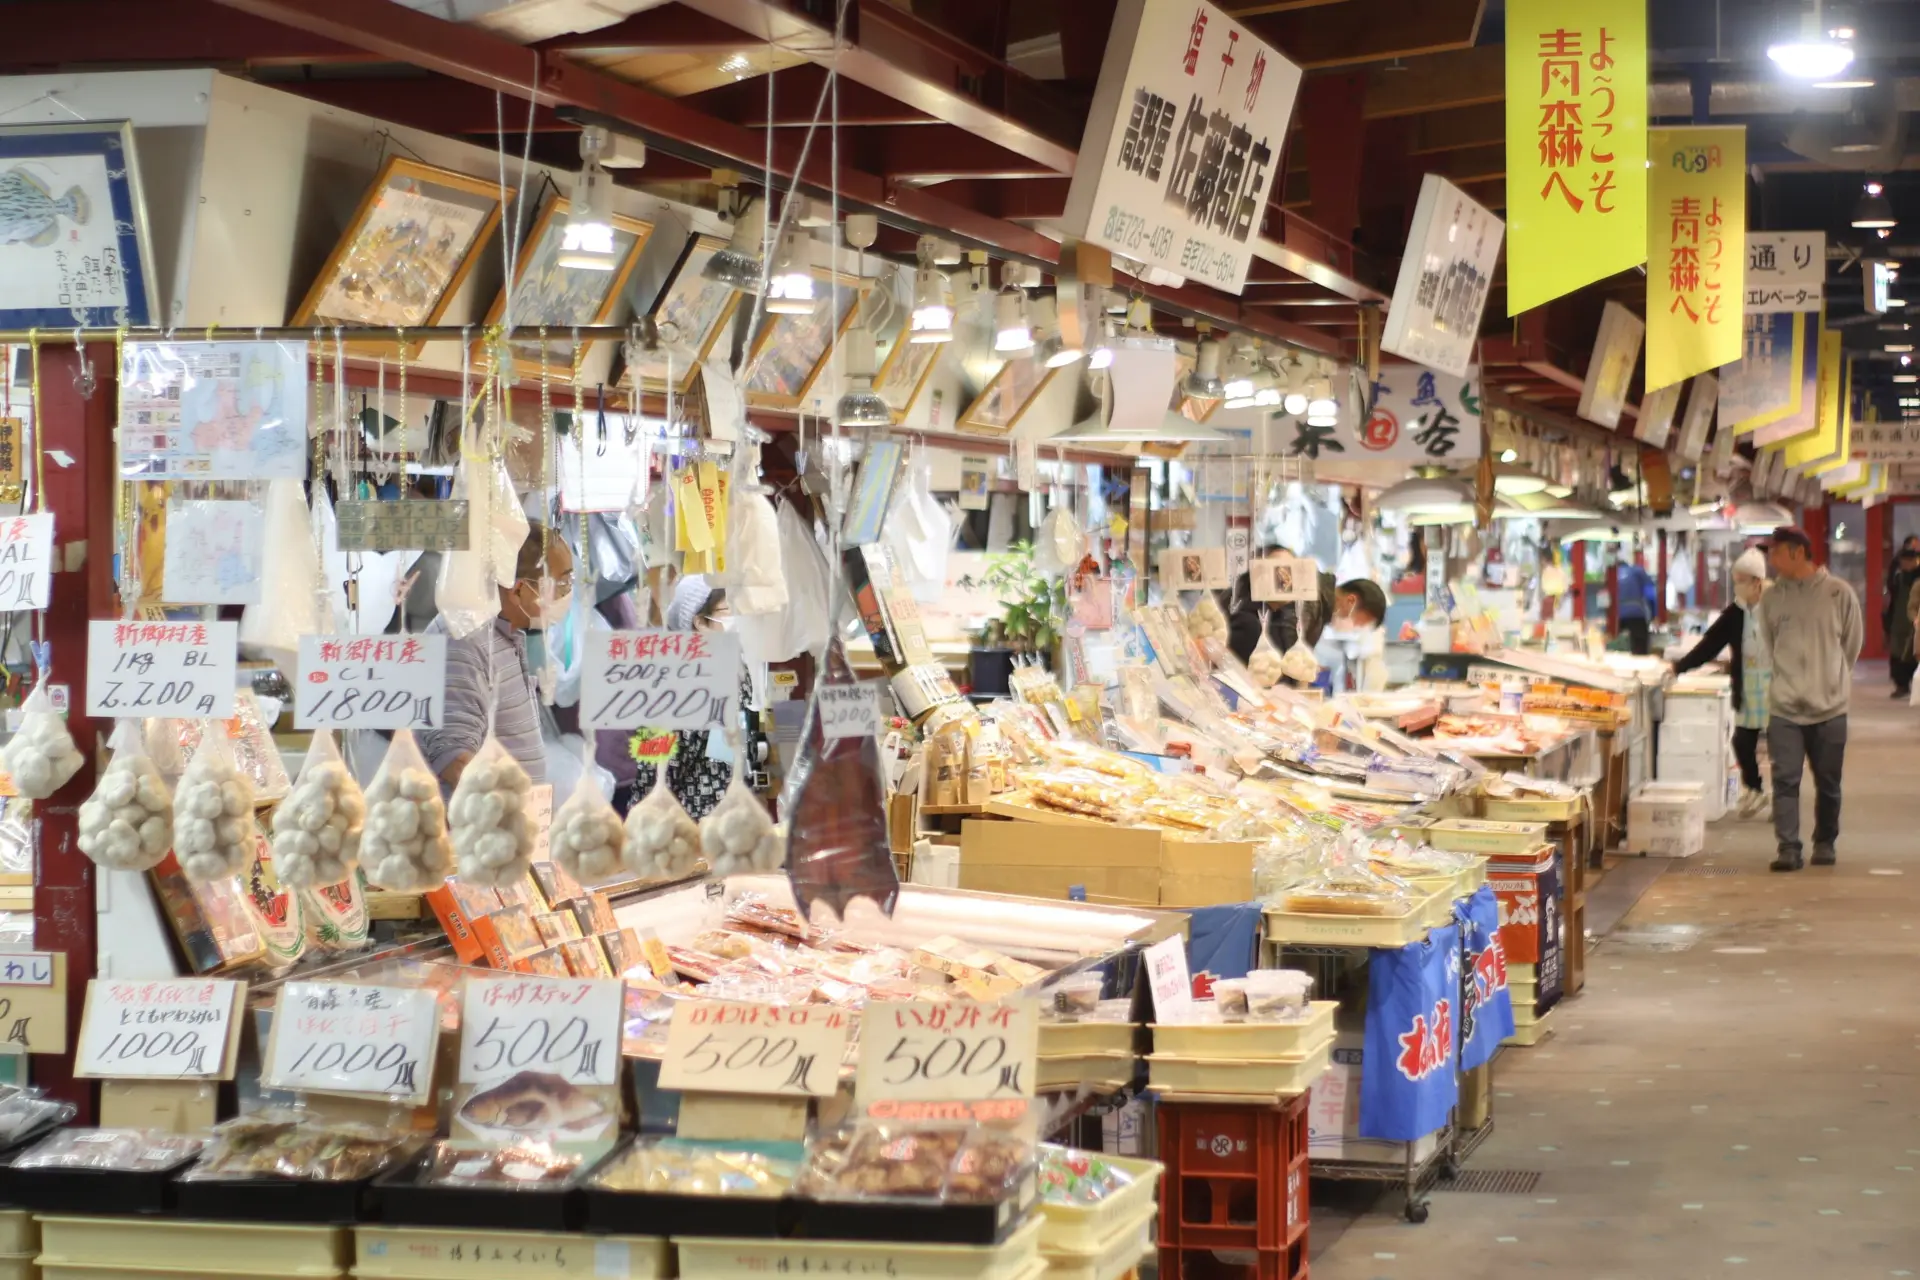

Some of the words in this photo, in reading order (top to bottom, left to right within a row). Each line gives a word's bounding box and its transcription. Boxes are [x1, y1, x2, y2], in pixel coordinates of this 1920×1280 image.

[1538, 28, 1584, 213] 青森へ
[1589, 27, 1617, 213] ようこそ
[1163, 93, 1271, 243] 佐藤商店
[1669, 196, 1701, 325] 青森へ
[1703, 196, 1724, 325] ようこそ
[1750, 243, 1812, 271] 通り
[1747, 288, 1820, 306] エレベーター
[183, 650, 217, 667] BL
[119, 1008, 221, 1026] とてもやわらかい
[473, 1016, 602, 1080] 500円
[689, 1005, 846, 1029] かわはぎロール
[682, 1033, 818, 1094] 500円
[883, 1035, 1025, 1097] 500円
